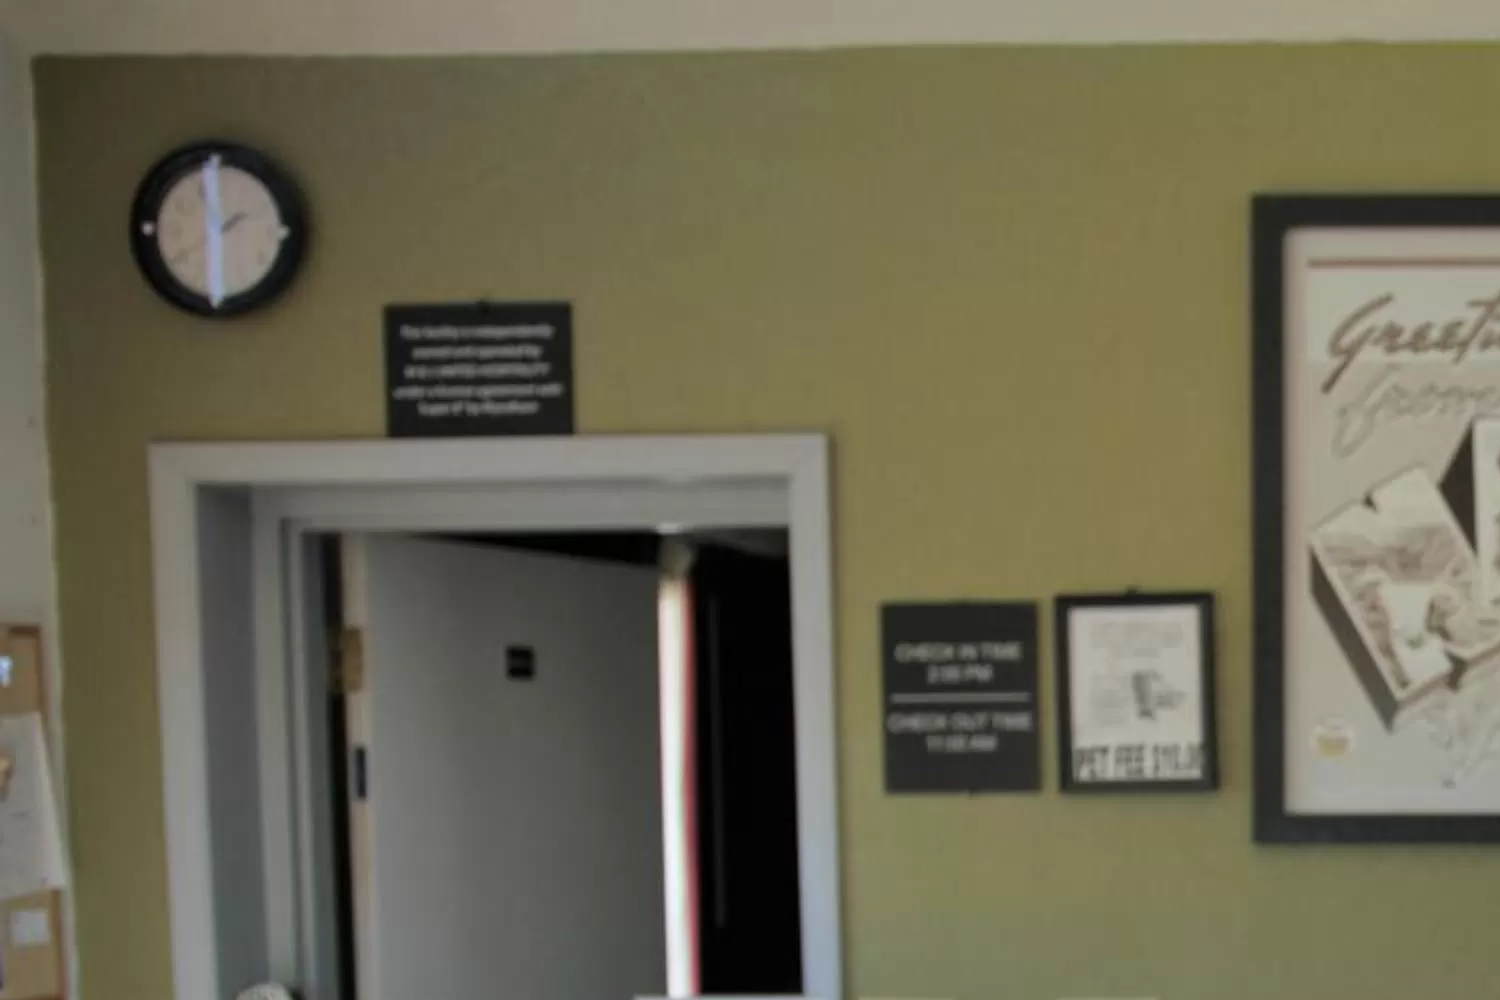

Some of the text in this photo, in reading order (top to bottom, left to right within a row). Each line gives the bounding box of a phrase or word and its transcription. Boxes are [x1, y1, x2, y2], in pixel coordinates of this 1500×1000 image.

[894, 641, 954, 663] CHECK
[980, 641, 1023, 662] TIME
[887, 711, 948, 734] CHECK
[991, 711, 1032, 732] TIME
